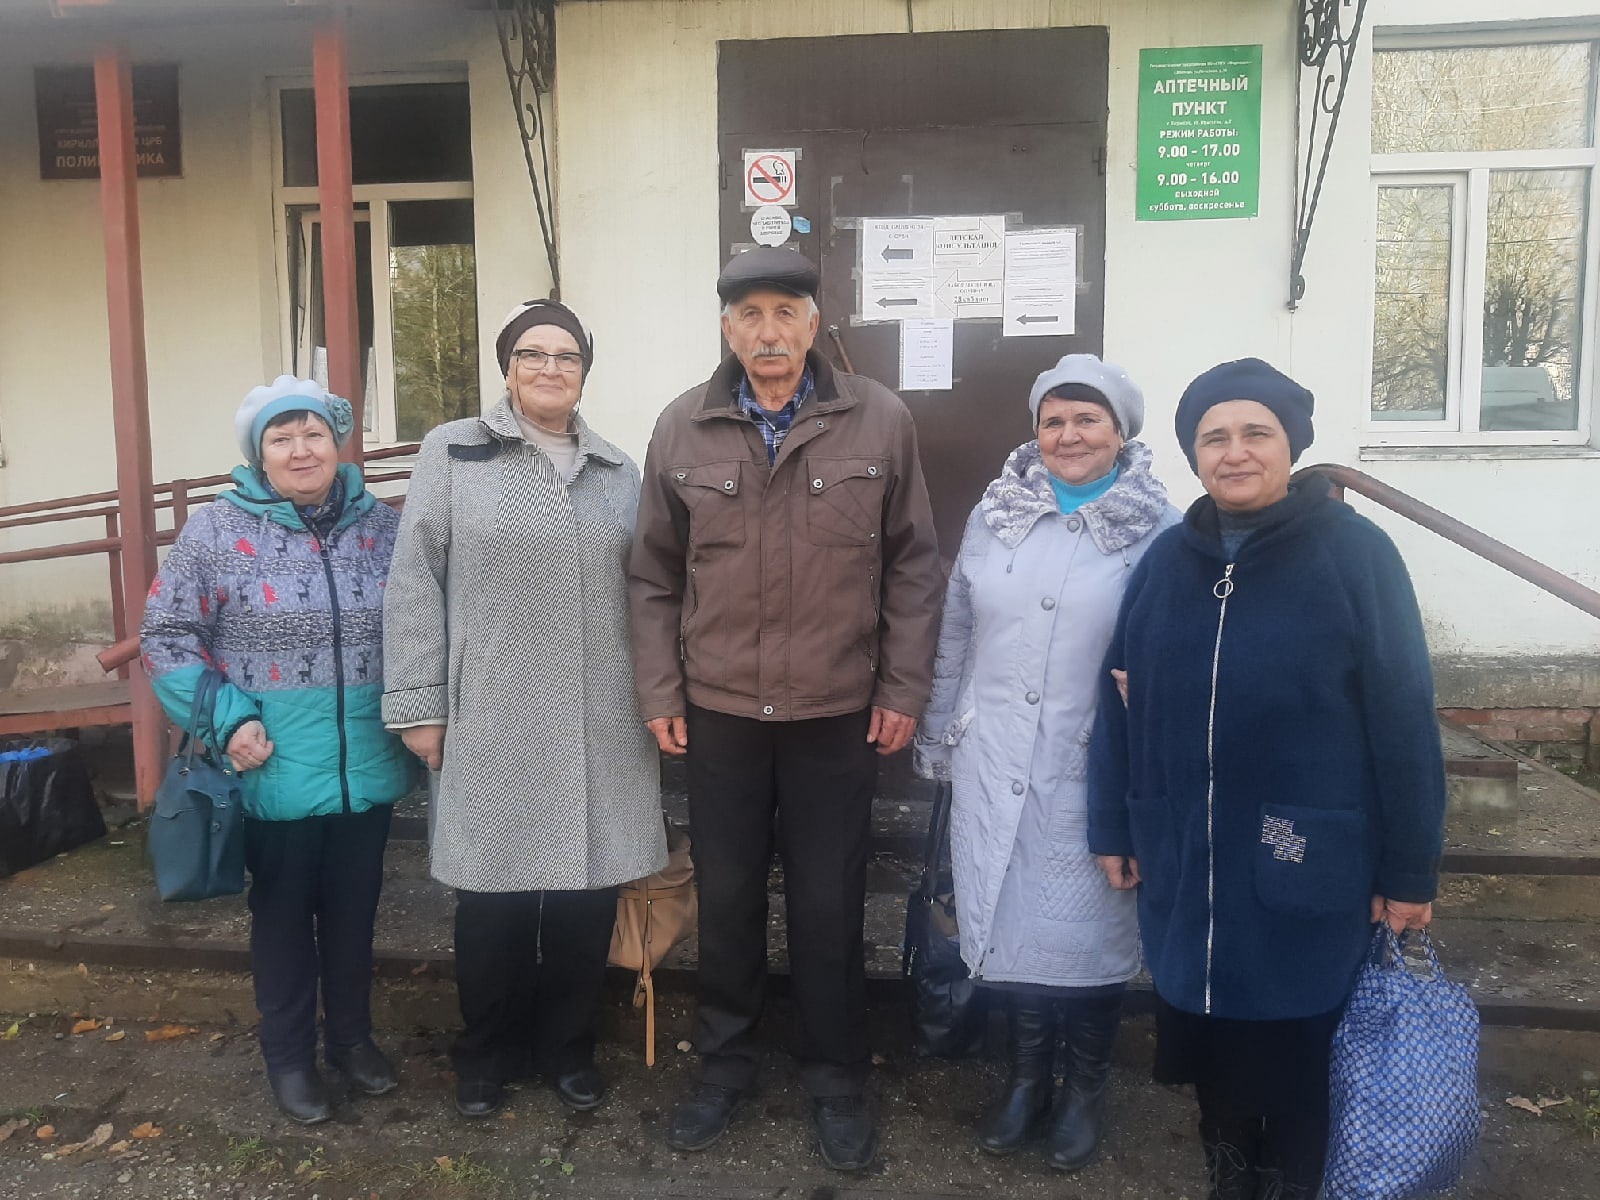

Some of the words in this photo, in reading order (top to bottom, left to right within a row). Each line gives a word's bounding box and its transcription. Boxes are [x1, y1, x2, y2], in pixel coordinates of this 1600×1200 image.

[1154, 74, 1249, 94] АПТЕЧНЫЙ
[1172, 101, 1227, 116] ПУНКТ
[1160, 130, 1195, 139] РЕЖИМ
[1197, 128, 1239, 138] РАБОТЫ:
[1158, 145, 1188, 158] 9.00
[1201, 143, 1241, 157] 17.00
[56, 152, 165, 168] ПОЛИИКА
[1157, 173, 1187, 186] 9.00
[1201, 171, 1240, 184] 16.00
[1175, 188, 1220, 199] выходной
[1188, 201, 1245, 211] воскресенье
